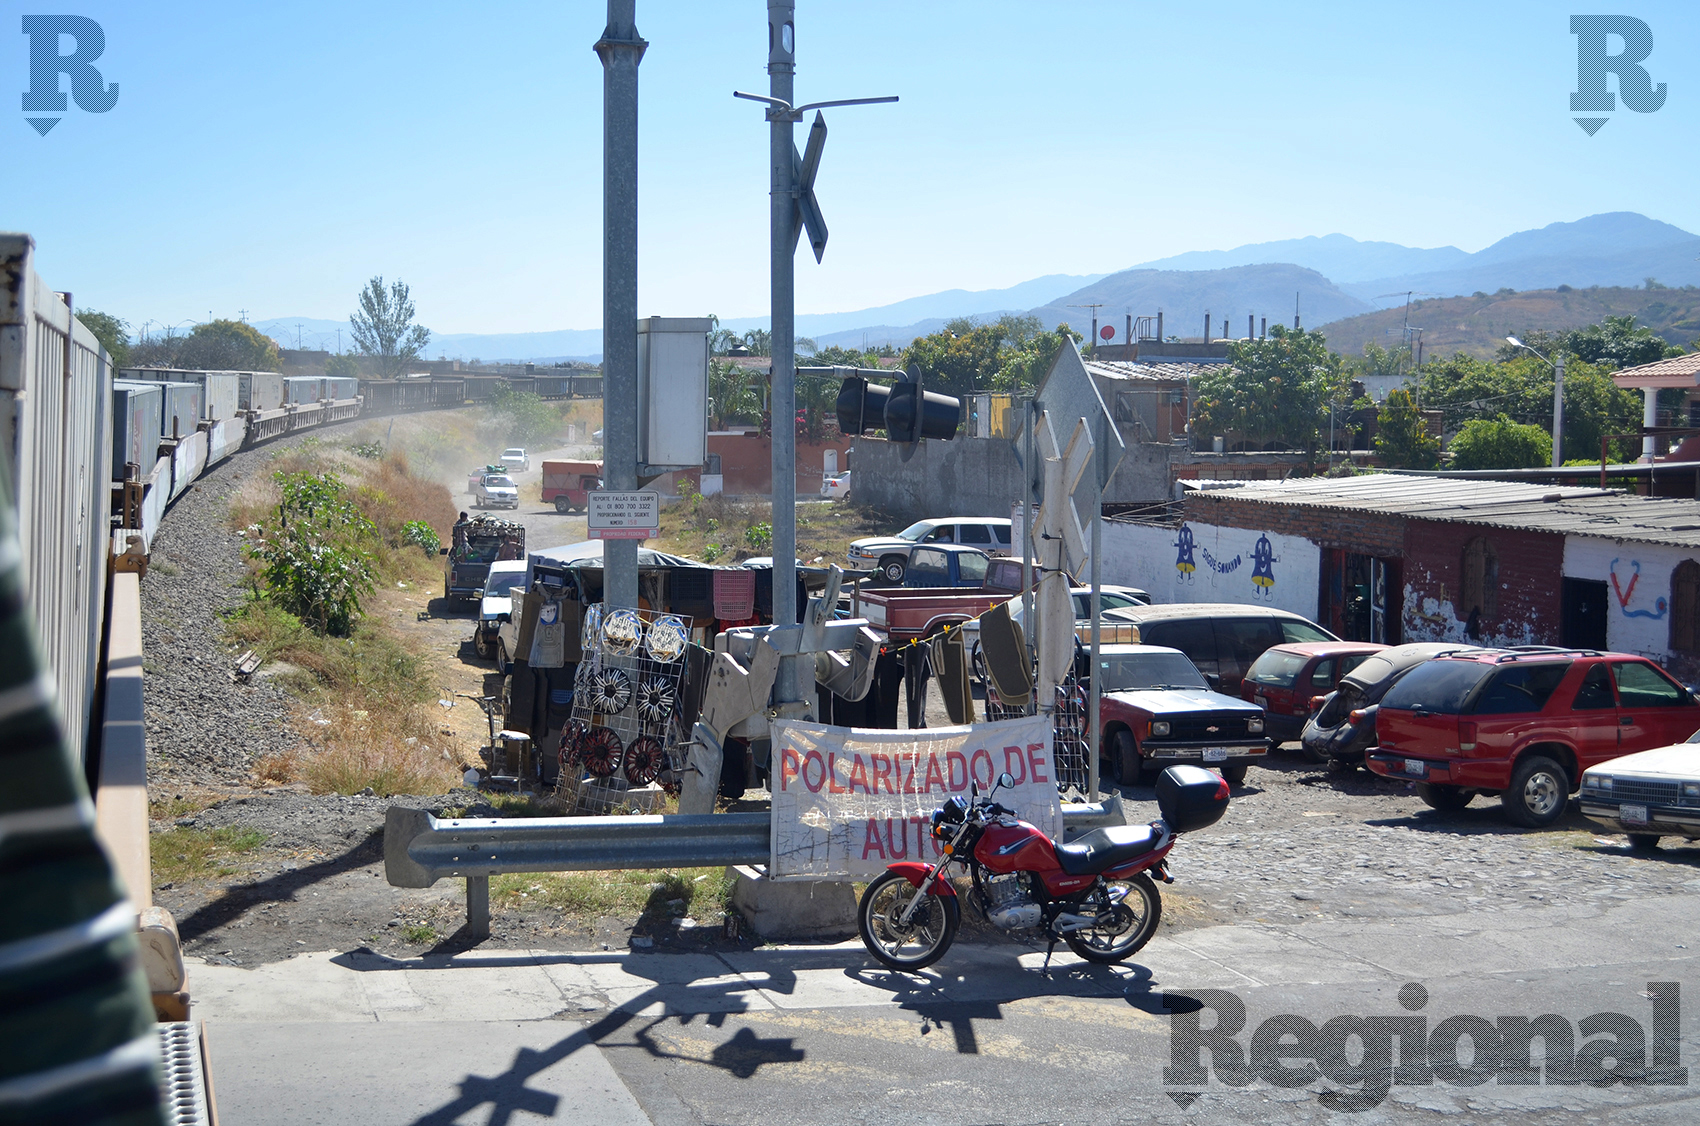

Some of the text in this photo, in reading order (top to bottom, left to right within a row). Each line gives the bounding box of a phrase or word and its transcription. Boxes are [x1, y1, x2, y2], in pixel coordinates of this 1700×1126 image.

[1202, 548, 1217, 571] SIGUE
[781, 742, 1048, 794] POLARIZADO DE
